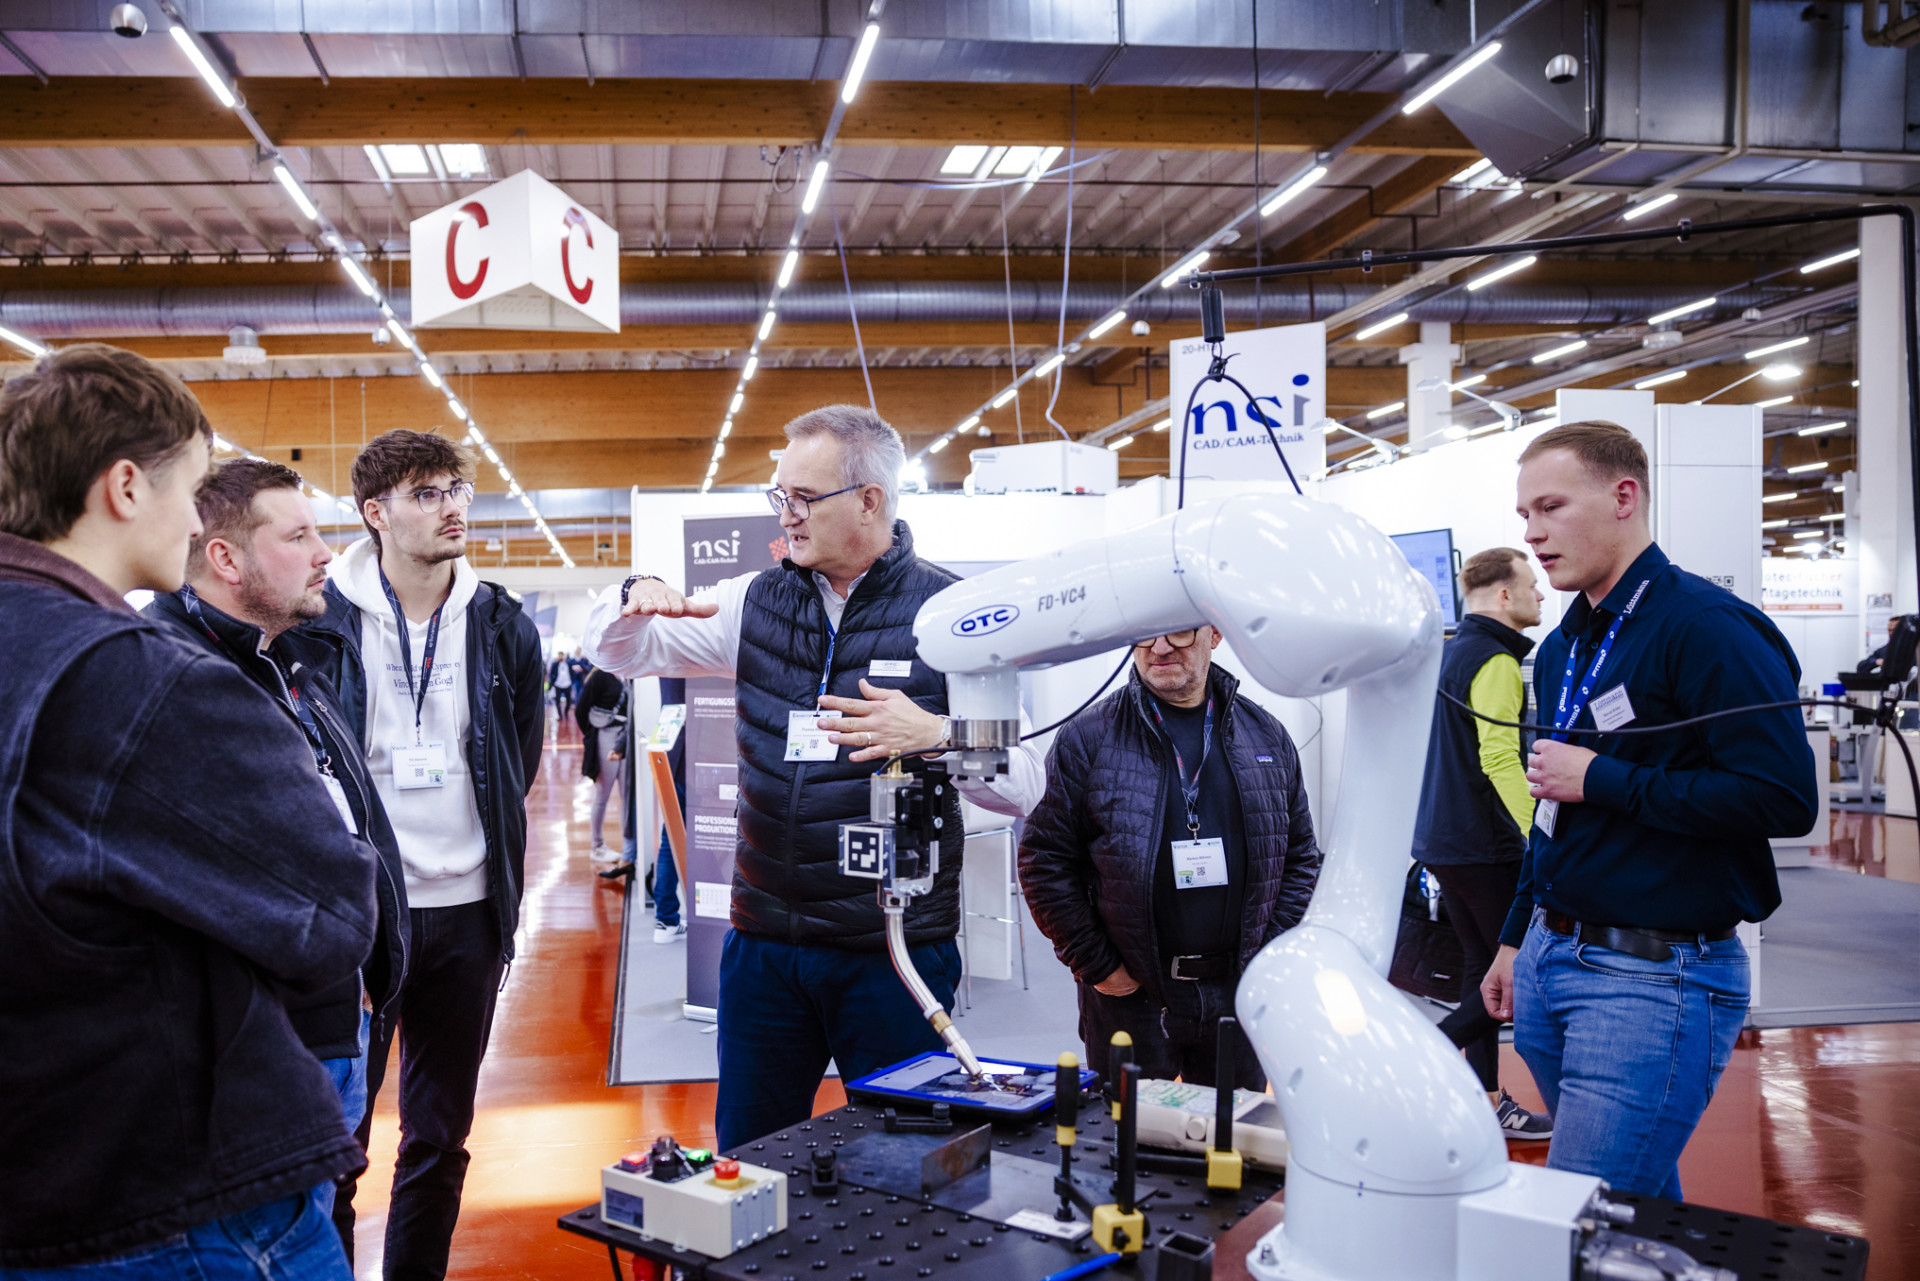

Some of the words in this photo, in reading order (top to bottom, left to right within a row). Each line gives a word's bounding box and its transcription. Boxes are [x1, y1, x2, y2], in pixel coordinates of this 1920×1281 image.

[446, 201, 490, 299] C
[561, 206, 594, 304] C
[1191, 374, 1311, 434] nsi
[1193, 432, 1304, 450] CAD/CAM-Thnik
[691, 530, 740, 557] nsi
[1038, 585, 1086, 612] FD-VC4
[961, 609, 1009, 632] OTC
